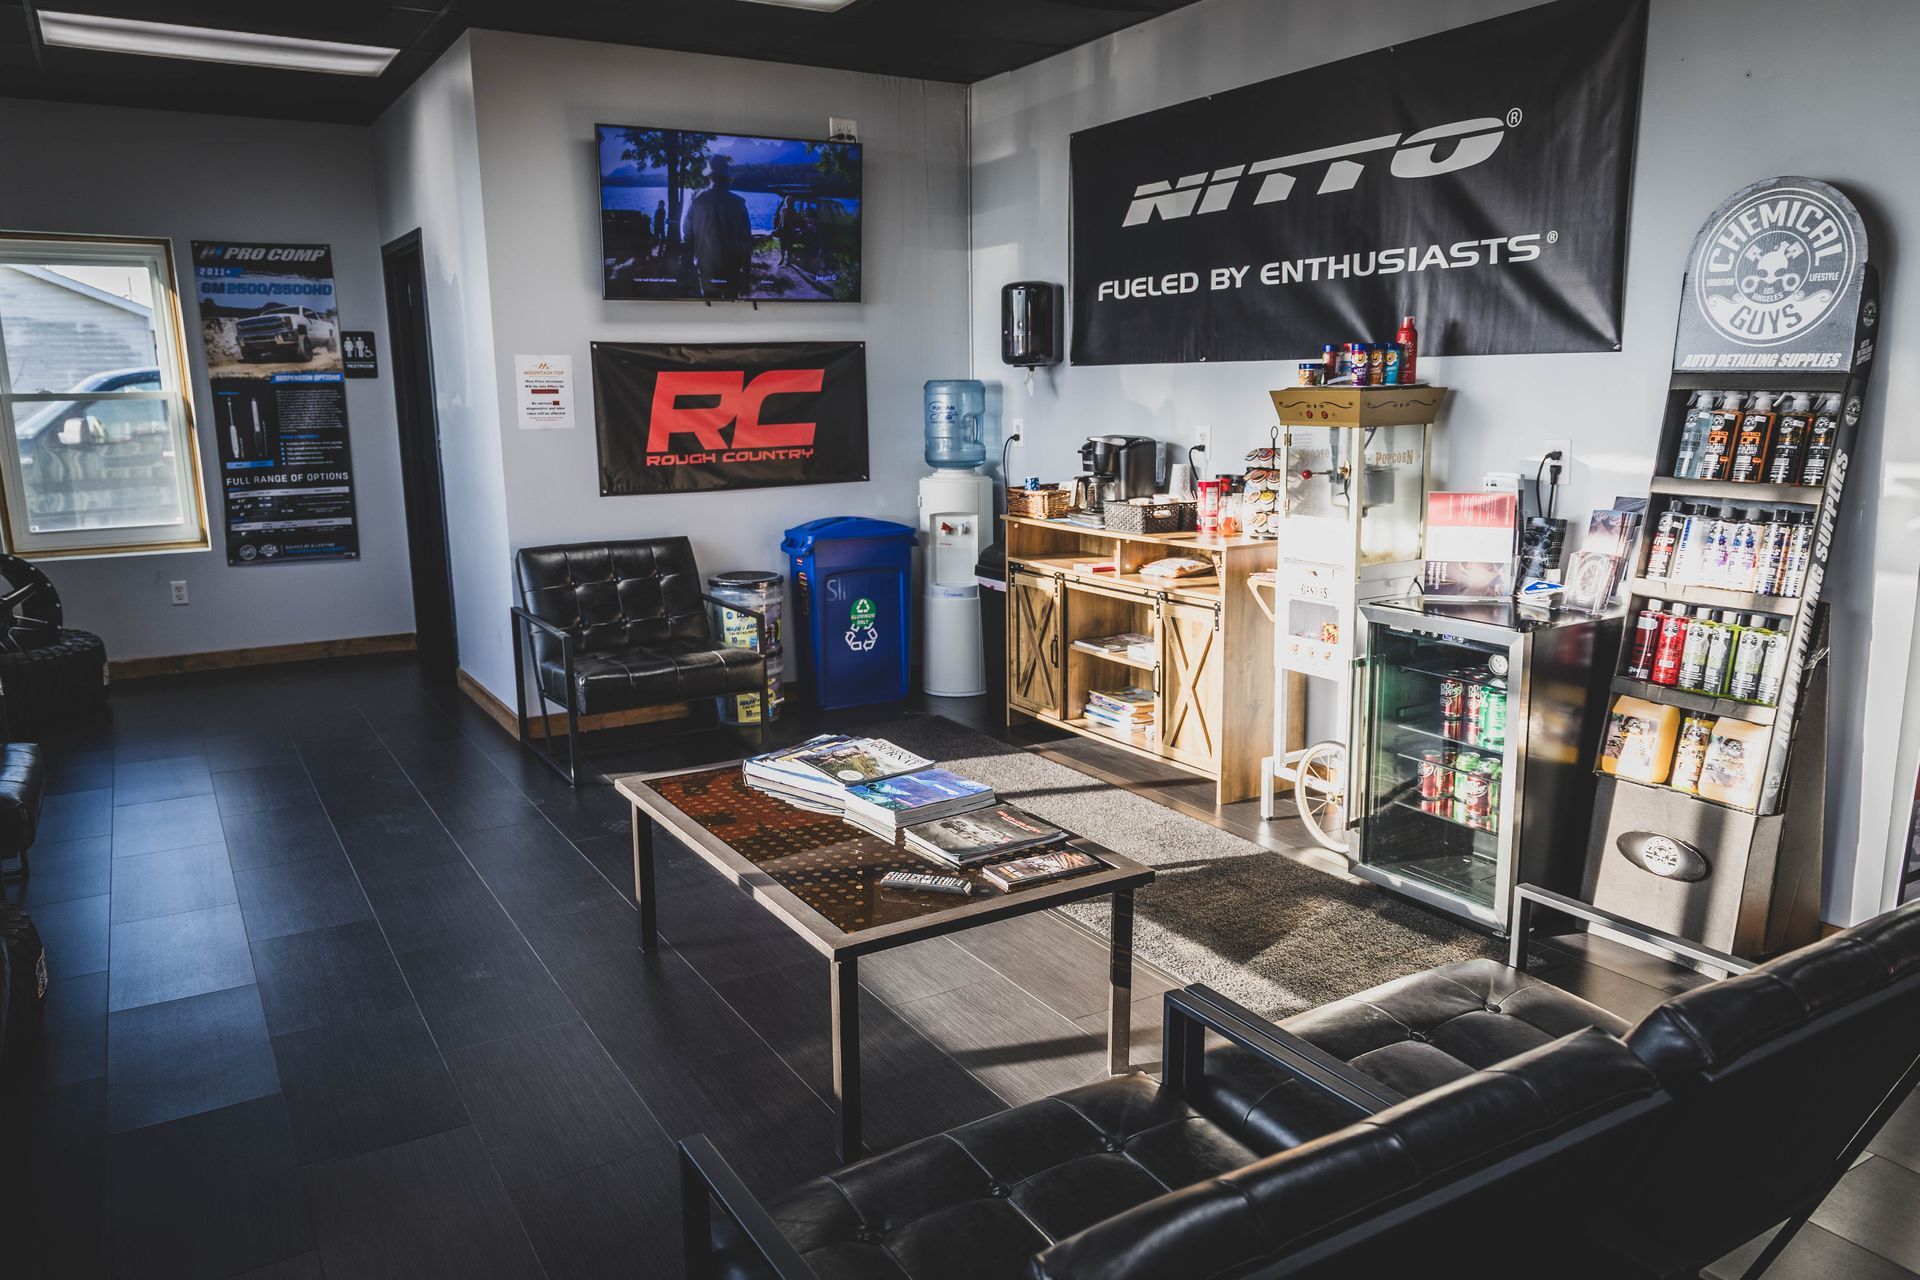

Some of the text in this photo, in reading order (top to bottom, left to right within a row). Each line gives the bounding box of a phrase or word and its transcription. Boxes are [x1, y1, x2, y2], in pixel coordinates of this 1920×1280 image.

[1121, 117, 1505, 228] NITTO
[1708, 200, 1843, 273] CHEMICAL
[224, 247, 326, 262] PRO COMP
[1098, 233, 1541, 302] FUELED BY ENTHUSIASTS
[1706, 277, 1735, 287] TRADITION
[1809, 271, 1840, 282] LIFESTYLE
[1751, 292, 1784, 301] ANGELES
[1763, 287, 1775, 295] LOS
[1728, 303, 1803, 335] GUYS
[1682, 352, 1842, 367] AUTO DETAILING SUPPLIES
[646, 368, 826, 453] RC
[646, 448, 814, 467] ROUGH COUNTRY
[1375, 449, 1414, 465] POPCORN
[226, 472, 349, 486] FULL RANGE OF OPTIONS
[1815, 448, 1849, 563] SUPPLIES
